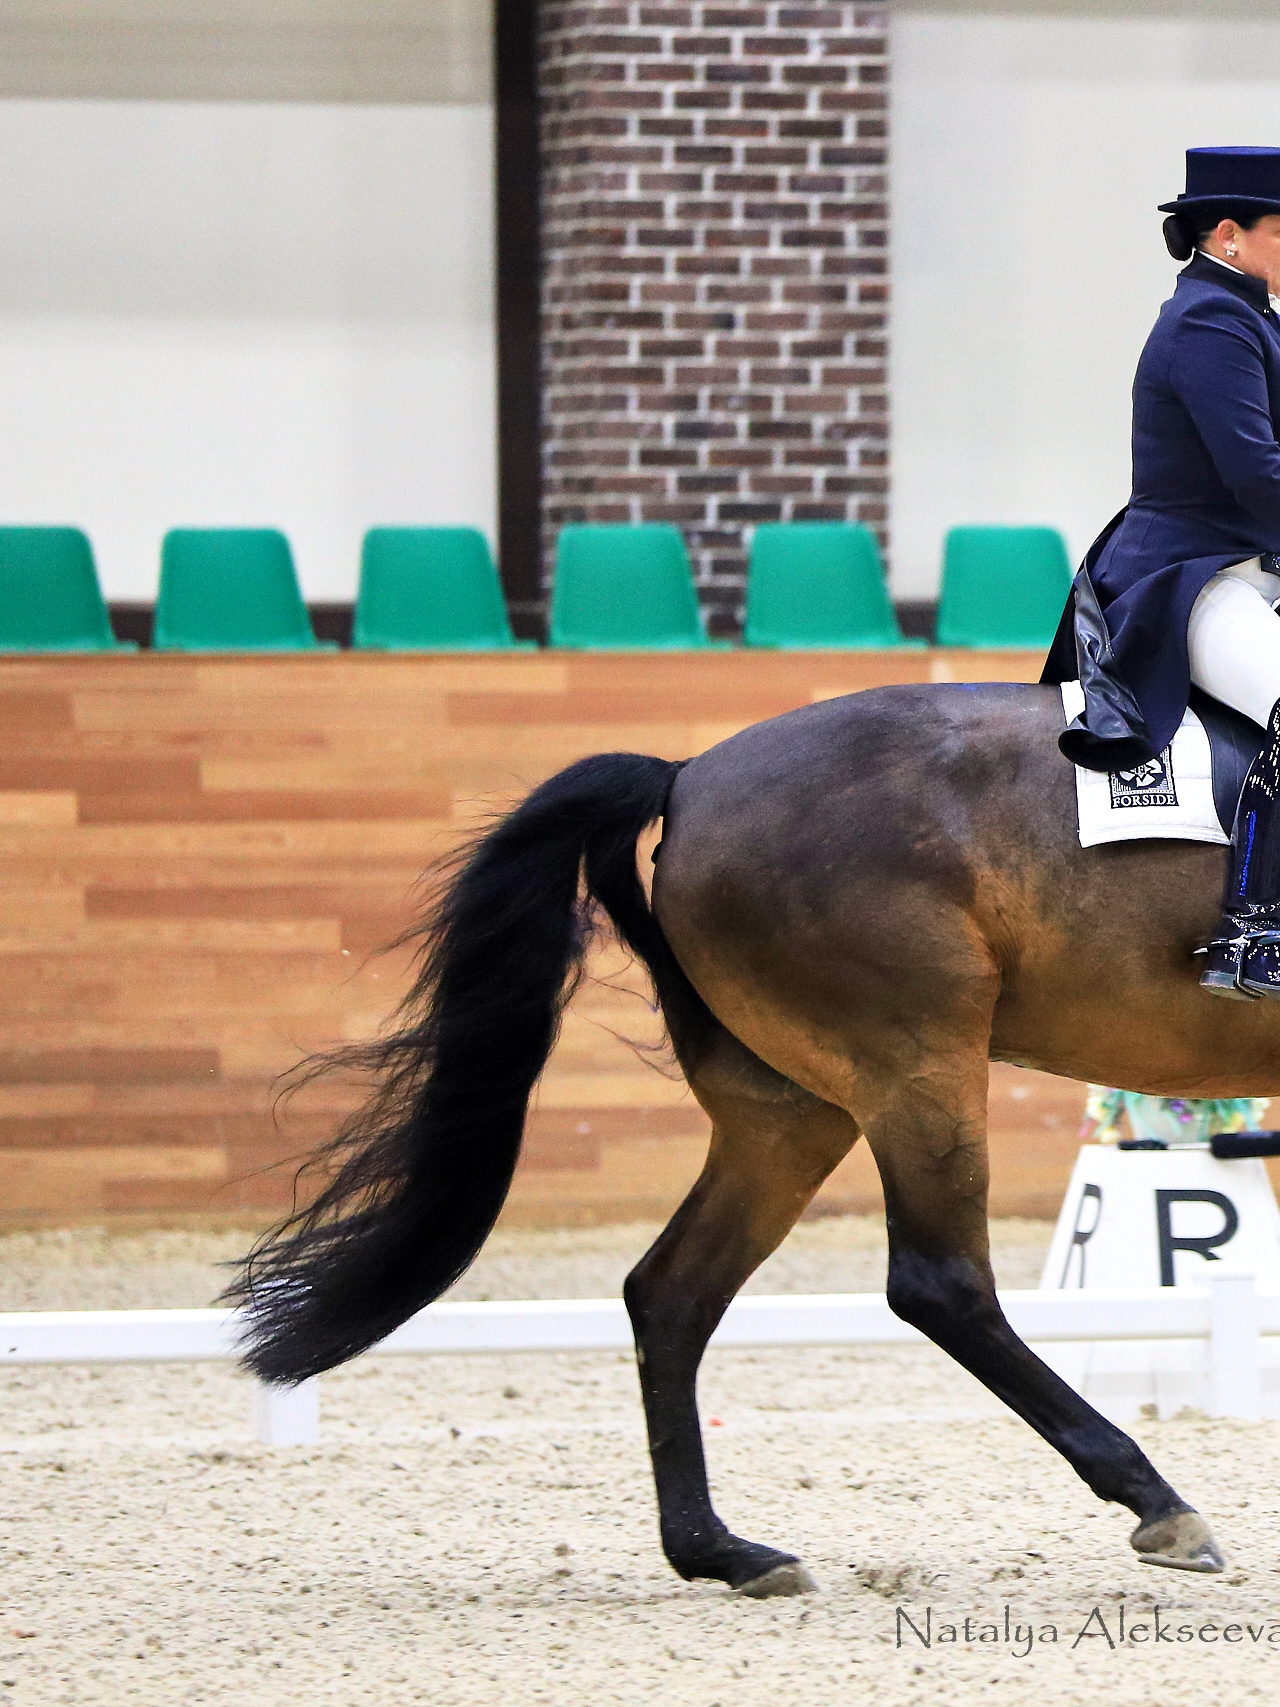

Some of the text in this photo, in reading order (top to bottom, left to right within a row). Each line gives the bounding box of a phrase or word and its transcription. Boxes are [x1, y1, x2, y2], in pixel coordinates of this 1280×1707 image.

[1112, 794, 1176, 808] FORSIDE
[1060, 1183, 1103, 1288] R
[1155, 1188, 1239, 1287] R
